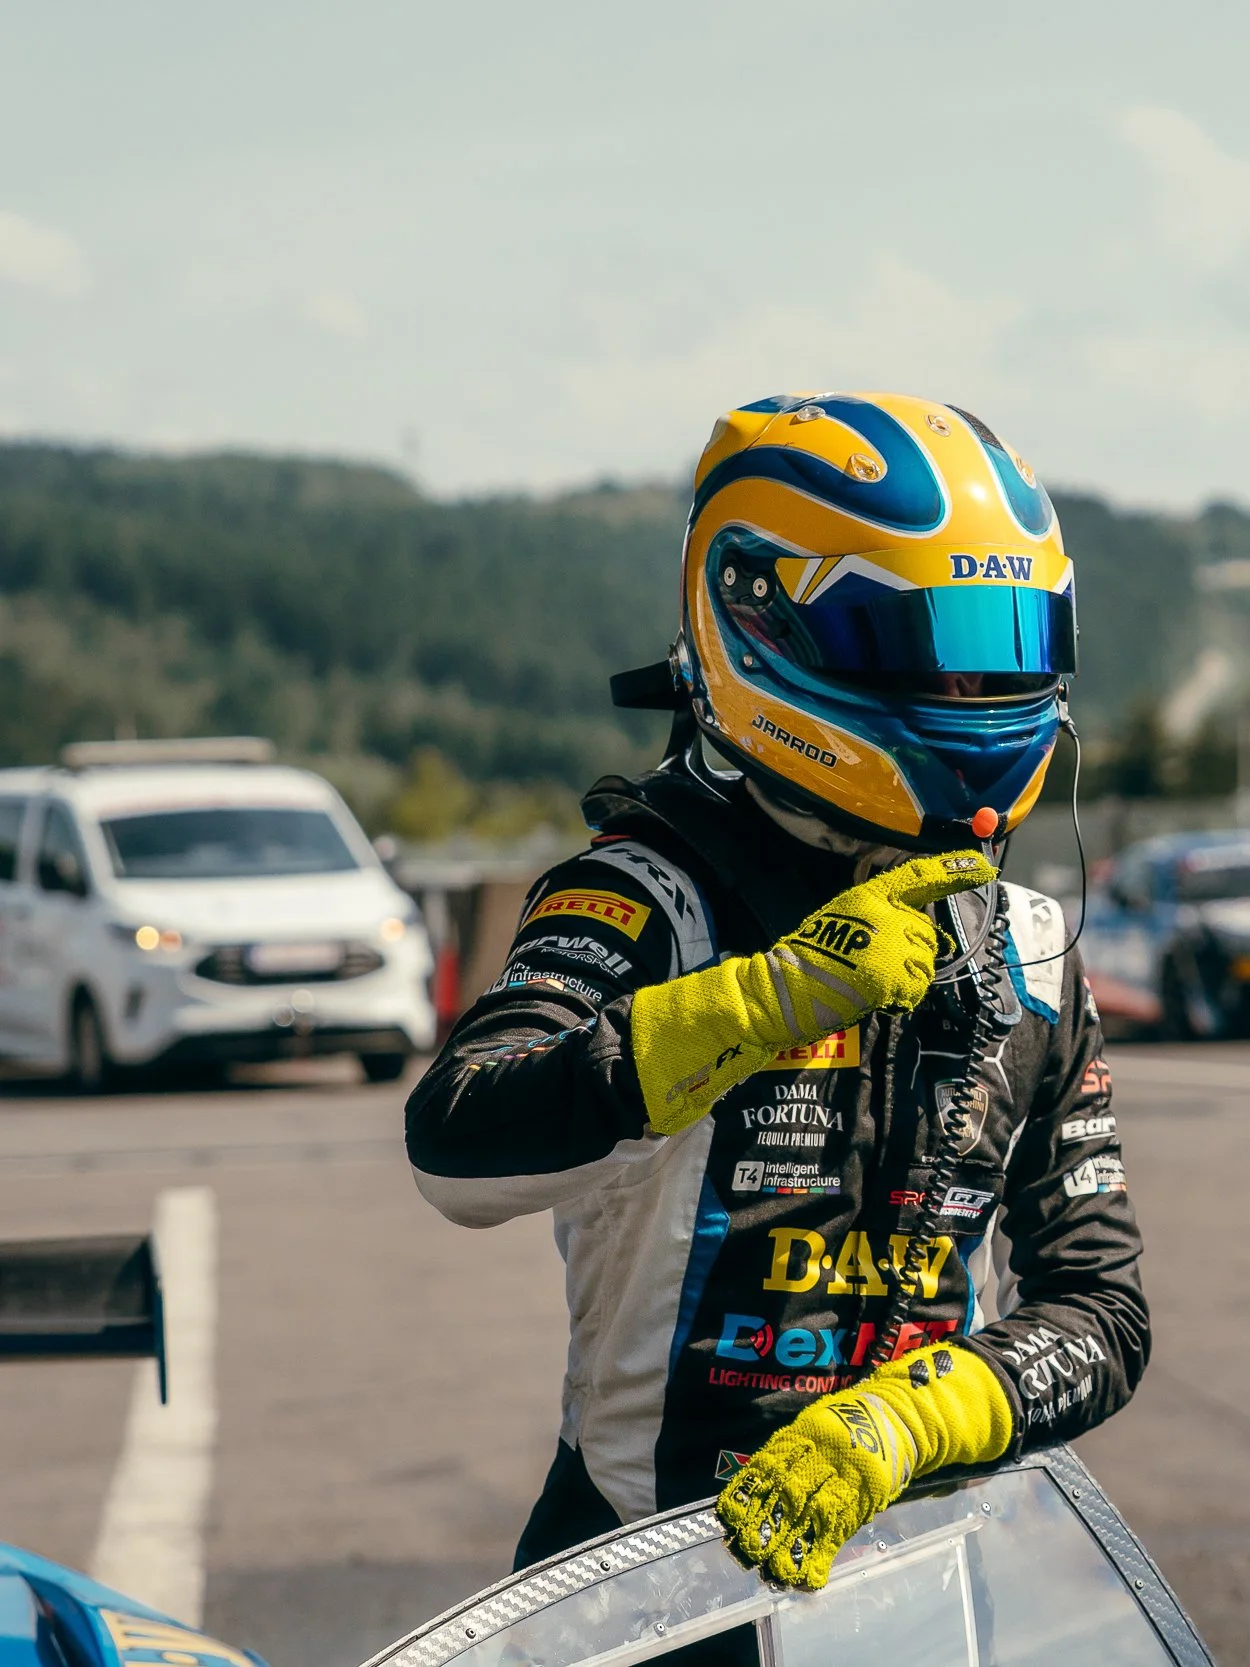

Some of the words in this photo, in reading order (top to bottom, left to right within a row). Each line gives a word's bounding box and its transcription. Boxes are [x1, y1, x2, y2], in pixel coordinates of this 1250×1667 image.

[751, 713, 839, 768] JARROD
[799, 919, 872, 956] OMP
[510, 969, 603, 1002] infrastructure
[774, 1083, 818, 1100] DAMA
[741, 1103, 844, 1132] FORTUNA
[757, 1132, 789, 1146] TEQUILA
[791, 1133, 825, 1147] PREMIUM
[739, 1168, 758, 1184] T4
[766, 1161, 819, 1176] intelligent
[763, 1175, 841, 1187] infrastructure
[709, 1368, 791, 1393] LIGHTING
